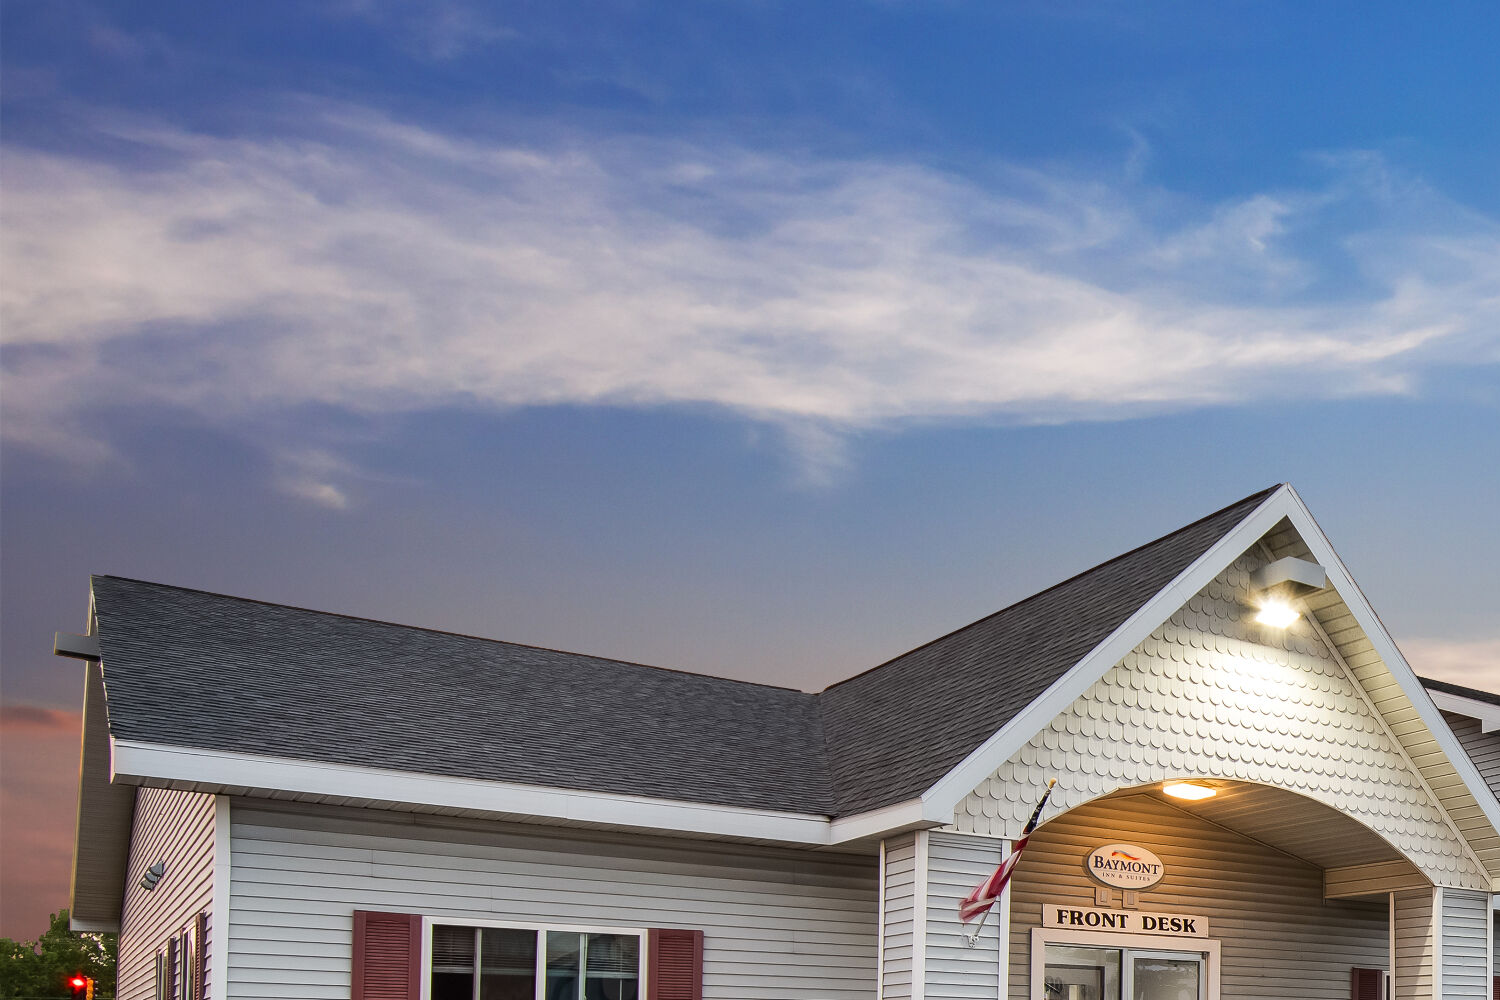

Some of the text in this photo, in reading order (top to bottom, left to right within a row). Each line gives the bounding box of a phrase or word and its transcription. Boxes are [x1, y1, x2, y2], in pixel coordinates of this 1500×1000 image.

[1094, 855, 1160, 875] BAYMONT
[1057, 909, 1197, 933] FRONT DESK
